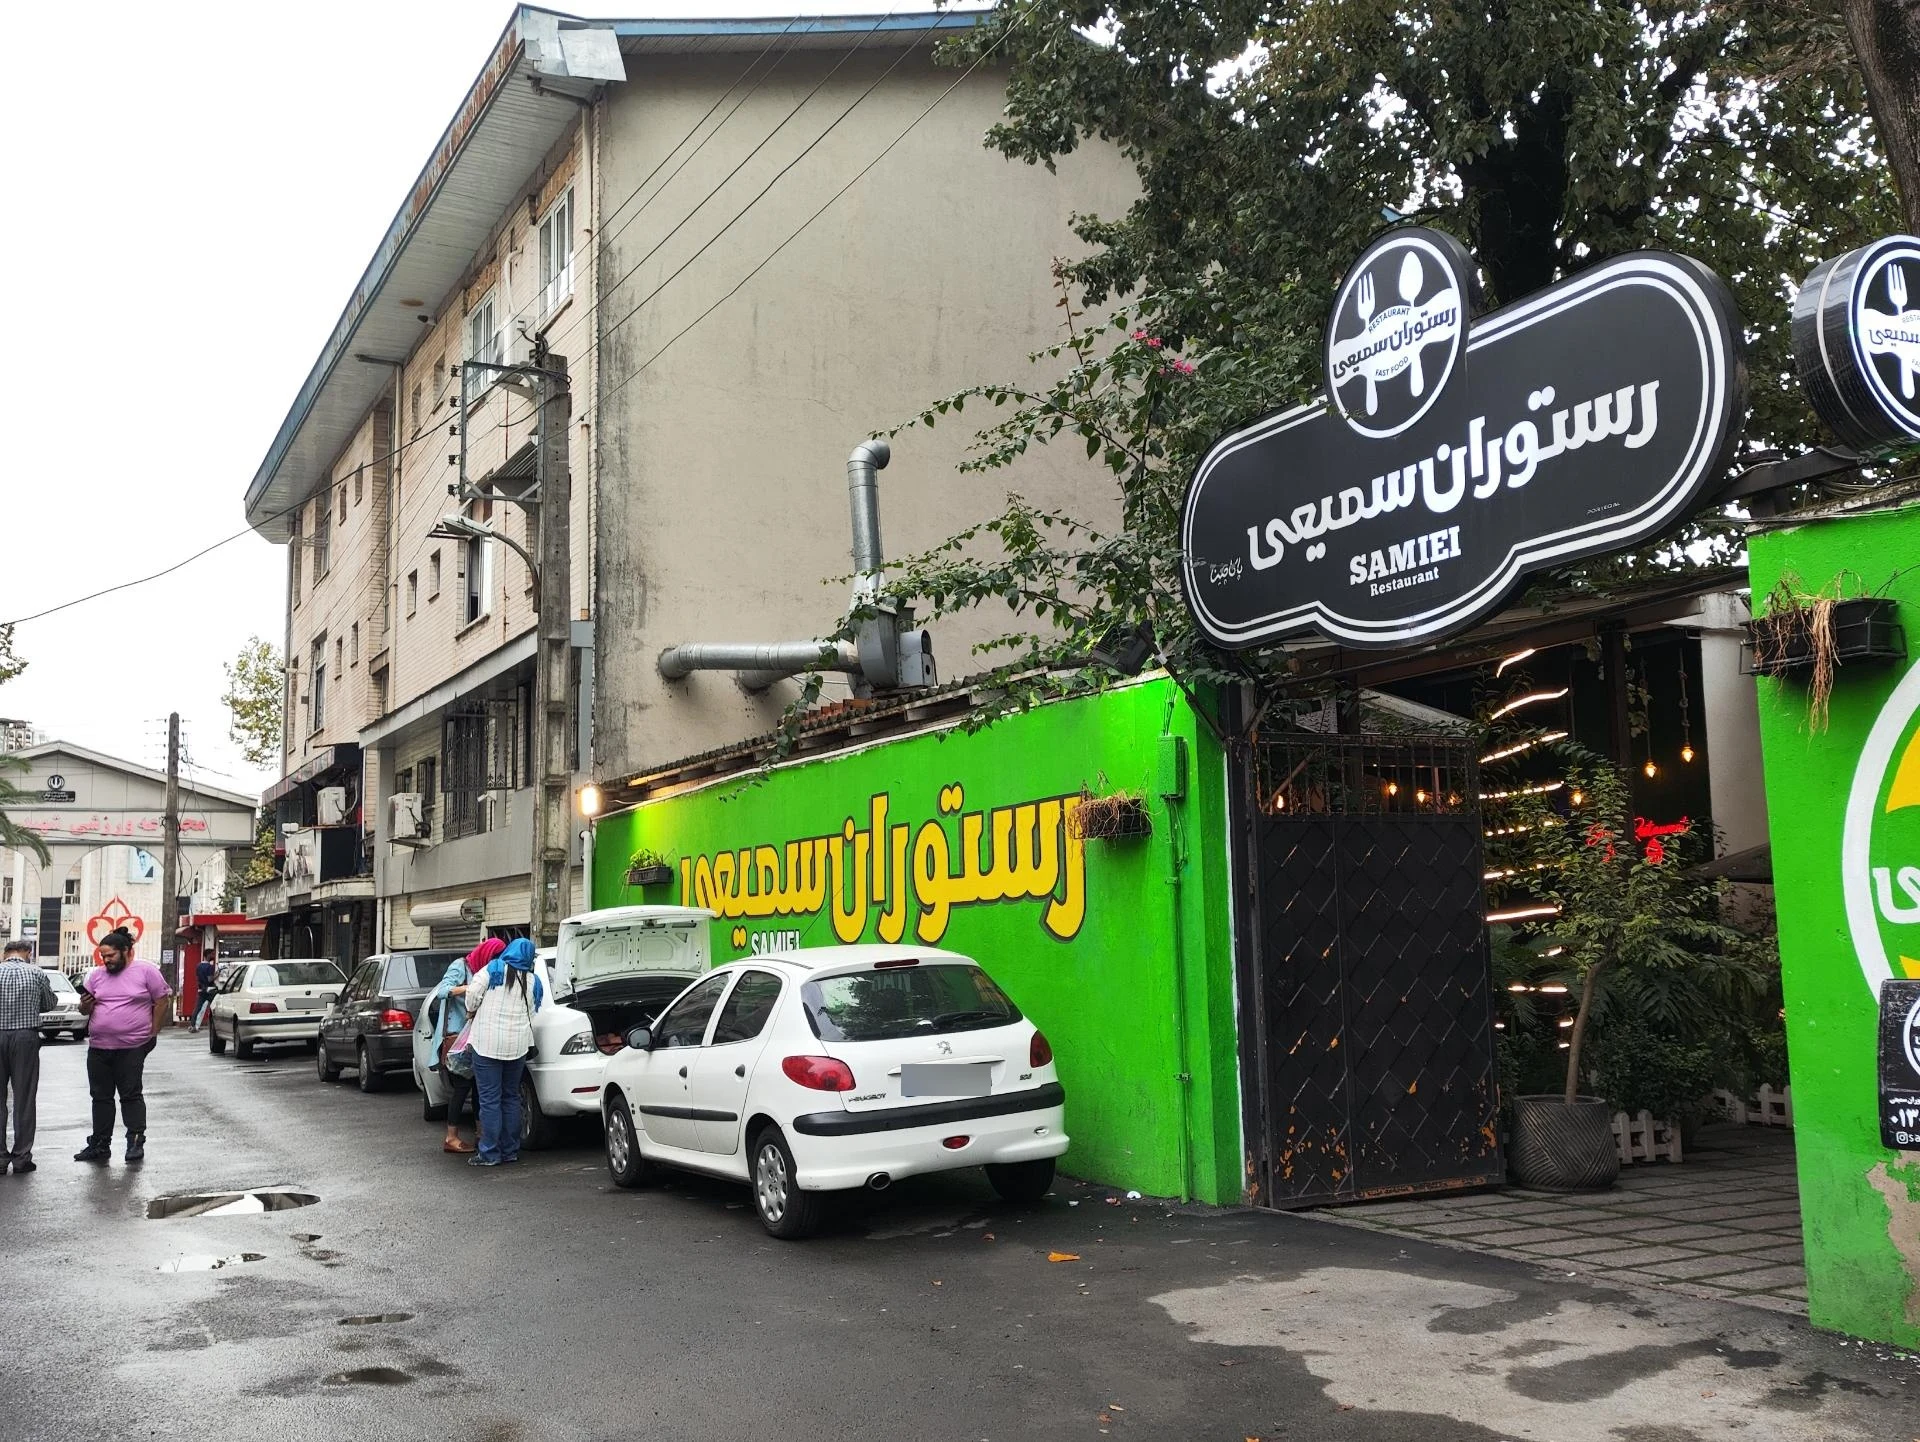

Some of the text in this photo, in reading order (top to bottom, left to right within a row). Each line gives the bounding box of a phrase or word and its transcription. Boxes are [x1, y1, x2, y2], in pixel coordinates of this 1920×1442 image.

[1332, 307, 1457, 379] رستوران سمیعی
[1368, 307, 1411, 333] RESTAURANT
[1375, 356, 1409, 377] FAST FOOD
[1246, 379, 1660, 571] رستوران سمیعی
[1349, 525, 1462, 586] SAMIEI
[1370, 566, 1440, 597] Restaurant
[823, 781, 1087, 947] رستوران
